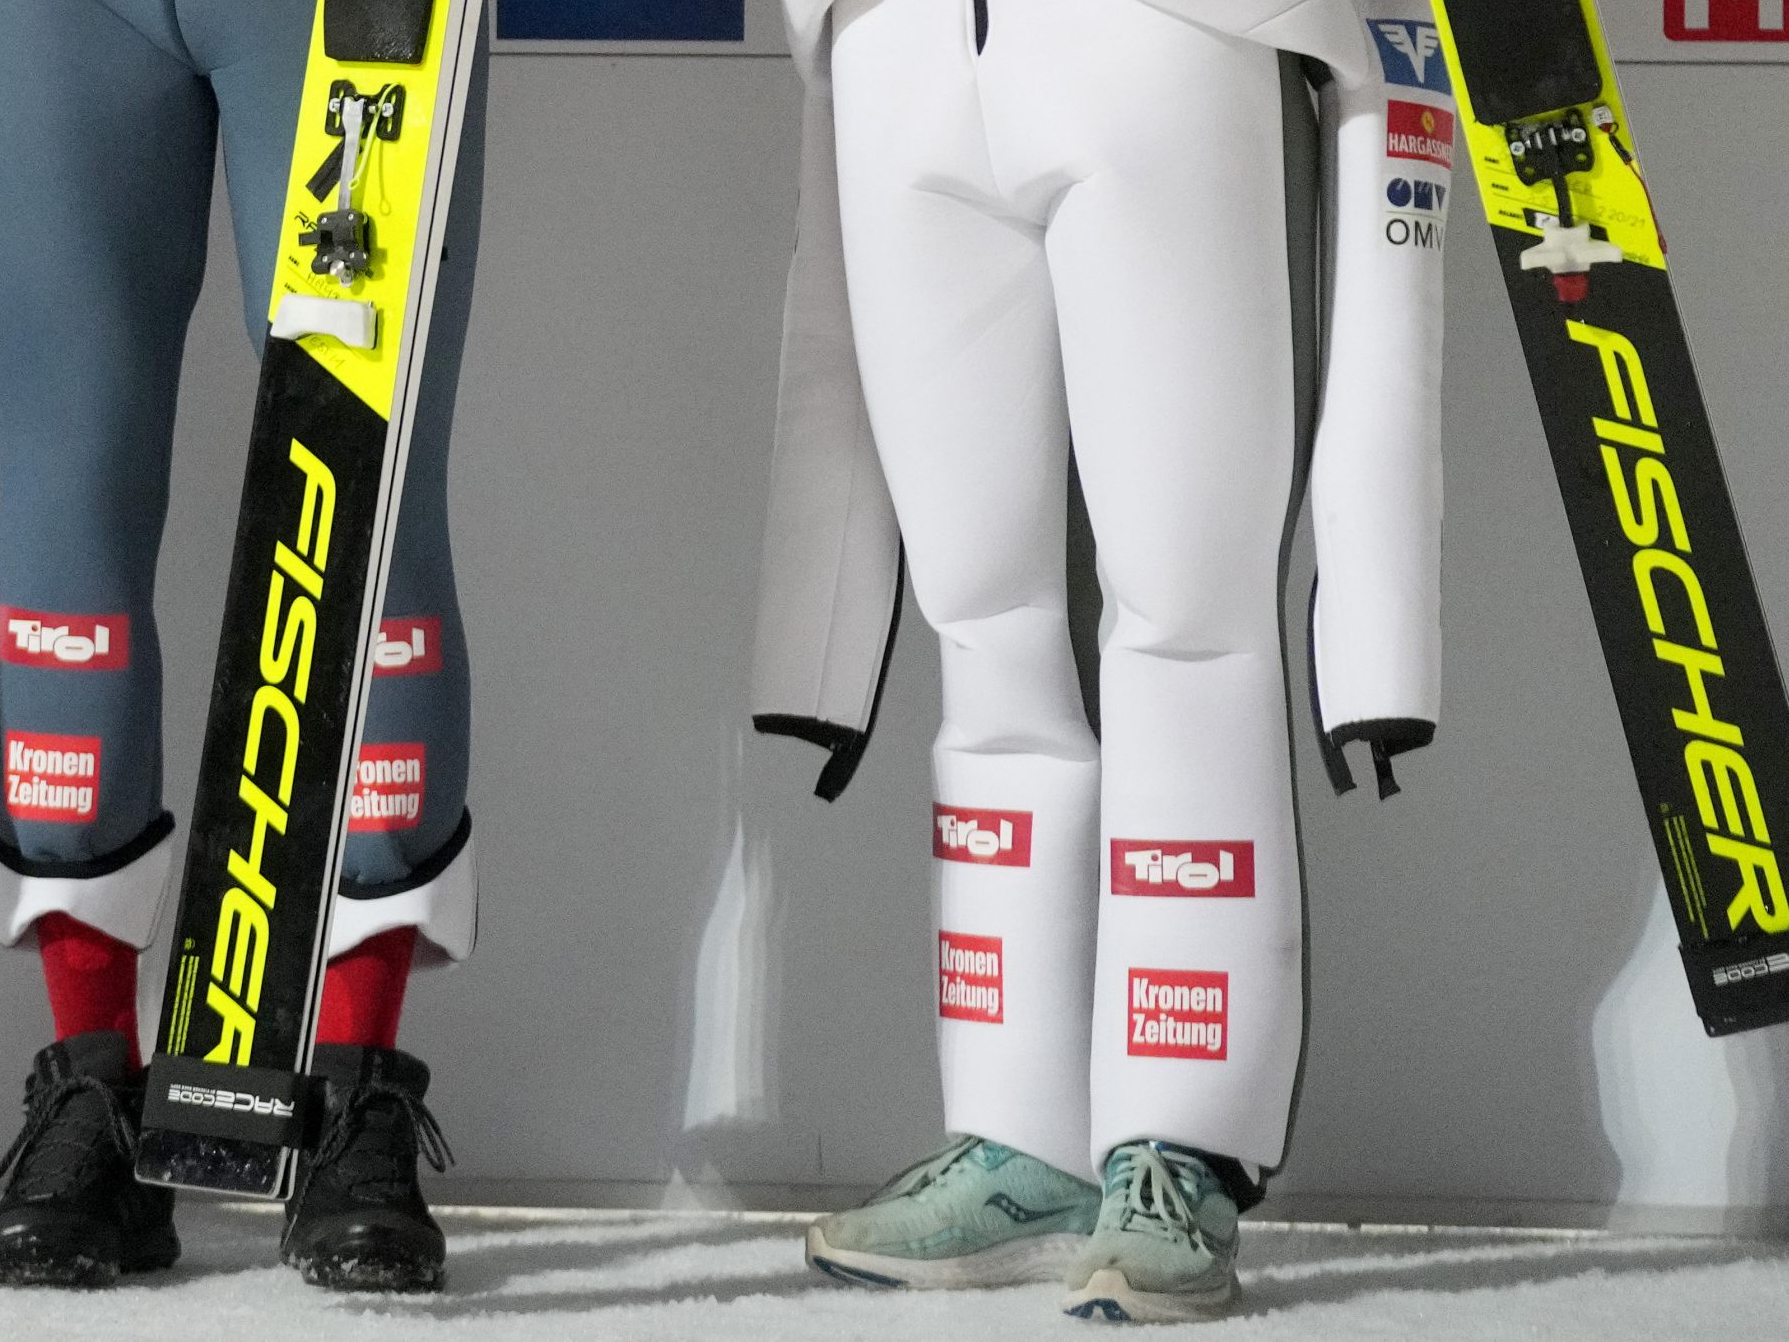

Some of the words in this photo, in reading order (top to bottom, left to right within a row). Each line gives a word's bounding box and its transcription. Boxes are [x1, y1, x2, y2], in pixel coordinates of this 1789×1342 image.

[1386, 219, 1444, 252] OMV
[8, 619, 110, 662] Tirol
[1566, 318, 1789, 936] FISCHER
[9, 740, 95, 777] Kronen
[8, 775, 93, 814] Zeitung
[350, 790, 419, 820] eitung
[937, 814, 1013, 857] Tirol
[1125, 849, 1235, 889] Tirol
[941, 940, 999, 977] Kronen
[941, 976, 999, 1015] Zeitung
[1132, 977, 1223, 1012] Kronen
[1132, 1013, 1223, 1051] Zeitung
